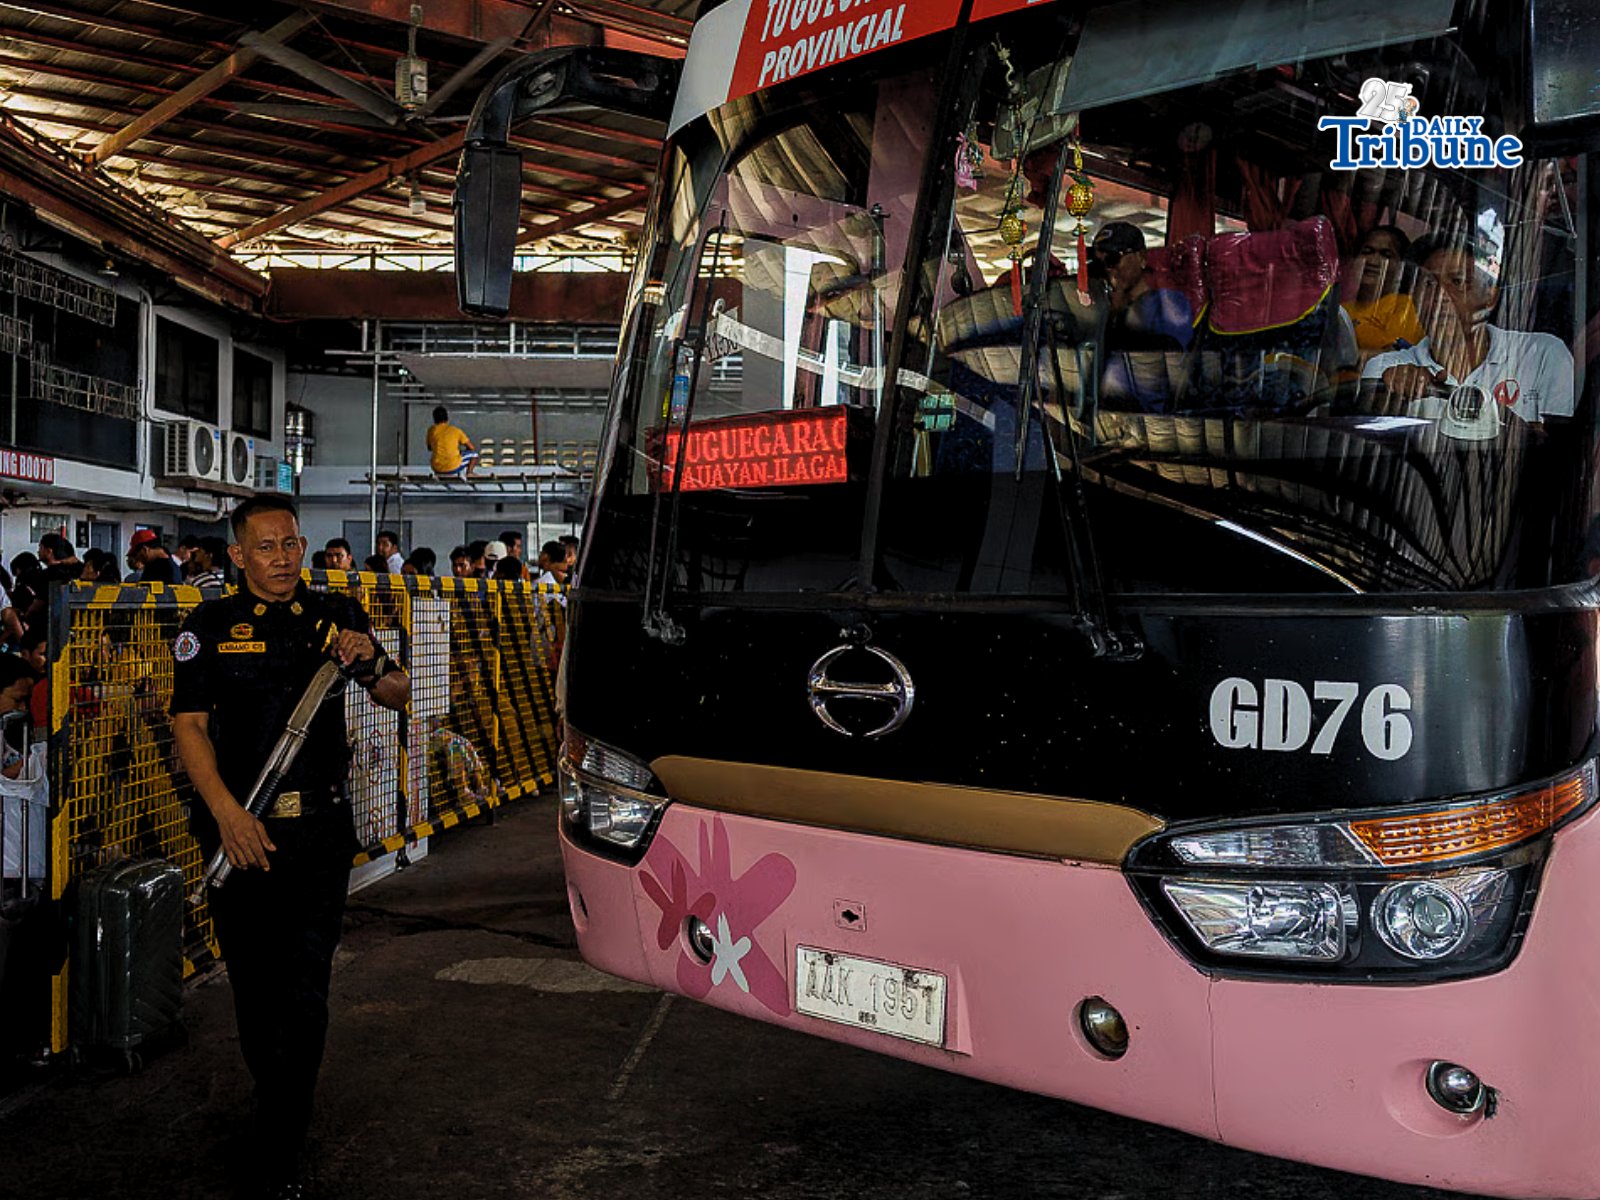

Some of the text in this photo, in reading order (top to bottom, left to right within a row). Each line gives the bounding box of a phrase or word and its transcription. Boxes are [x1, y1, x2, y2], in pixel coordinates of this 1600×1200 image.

[757, 3, 907, 88] PROVINCIAL
[19, 454, 53, 482] BOOTH
[1209, 676, 1413, 762] GD76
[805, 958, 854, 1007] AAK
